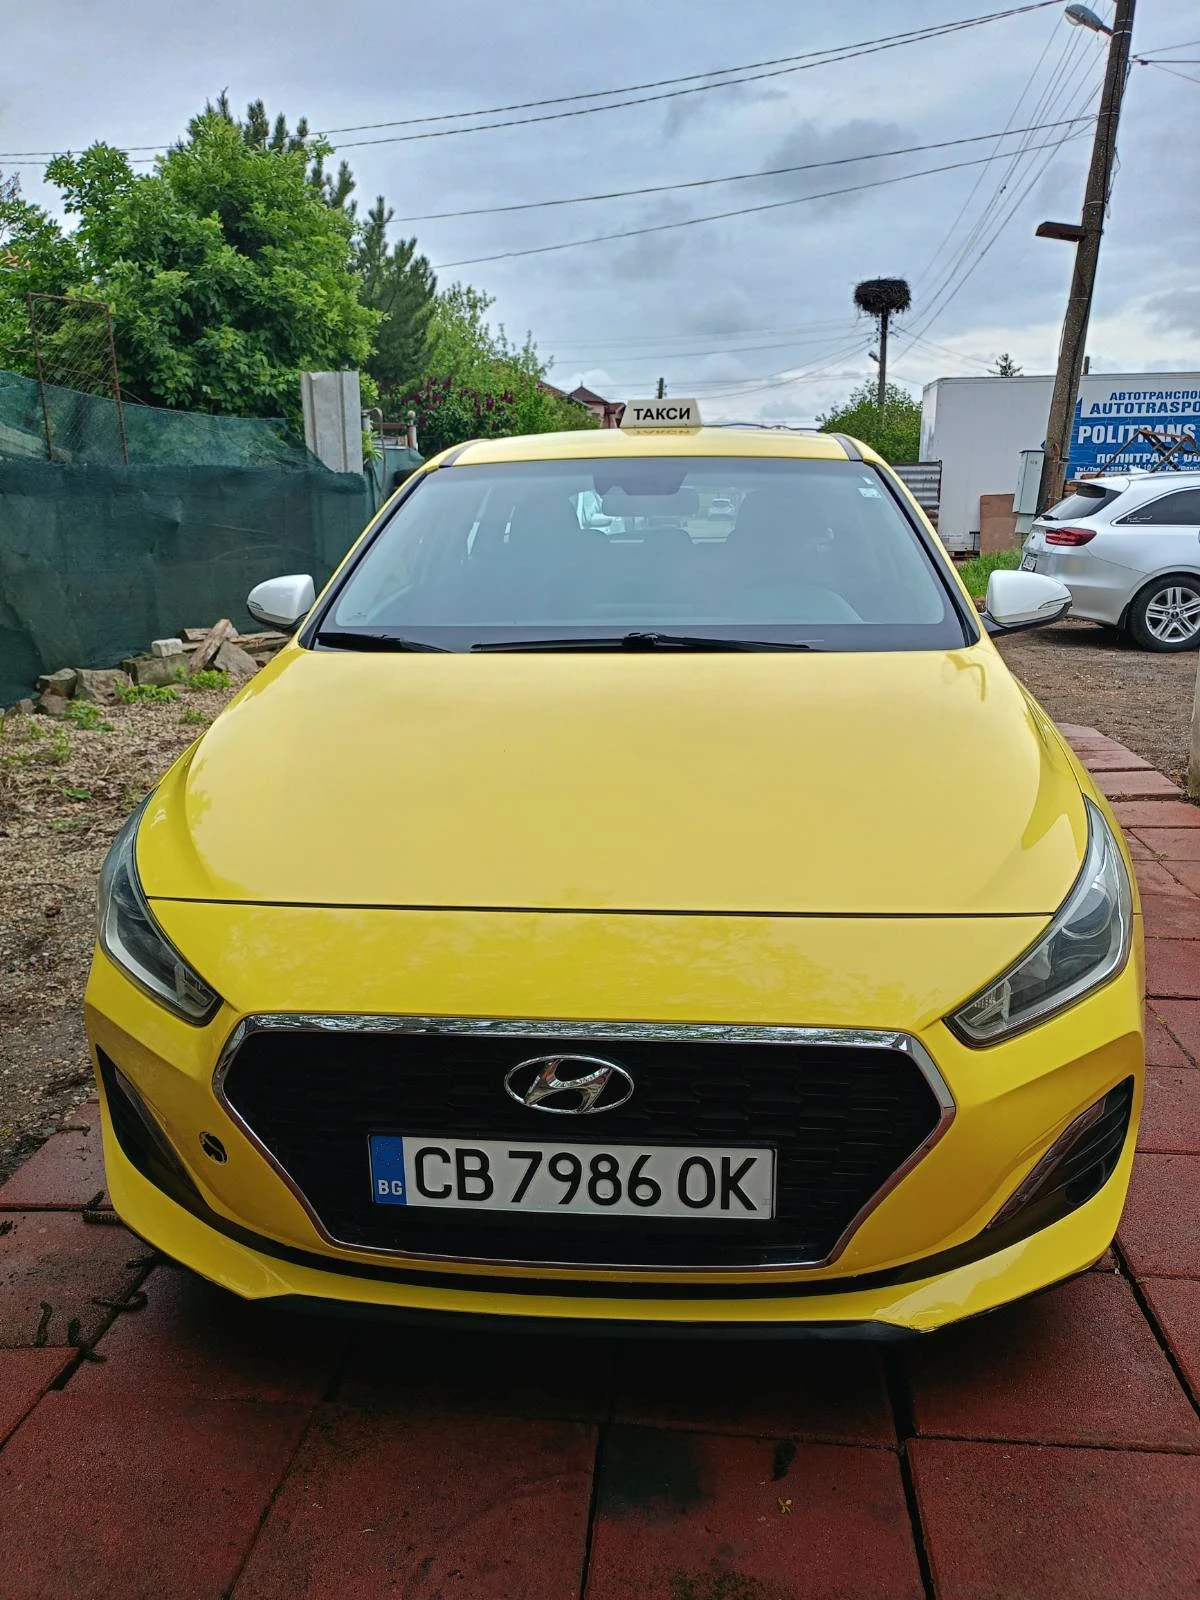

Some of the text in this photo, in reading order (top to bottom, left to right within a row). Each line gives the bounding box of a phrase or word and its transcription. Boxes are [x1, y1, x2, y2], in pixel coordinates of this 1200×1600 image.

[1110, 391, 1200, 401] АВТОТРАНСПО
[633, 408, 690, 420] ТАКСИ
[1096, 453, 1178, 464] ПОЛИТРАС
[414, 1146, 758, 1211] CB 7986 OK
[378, 1179, 402, 1195] BG
